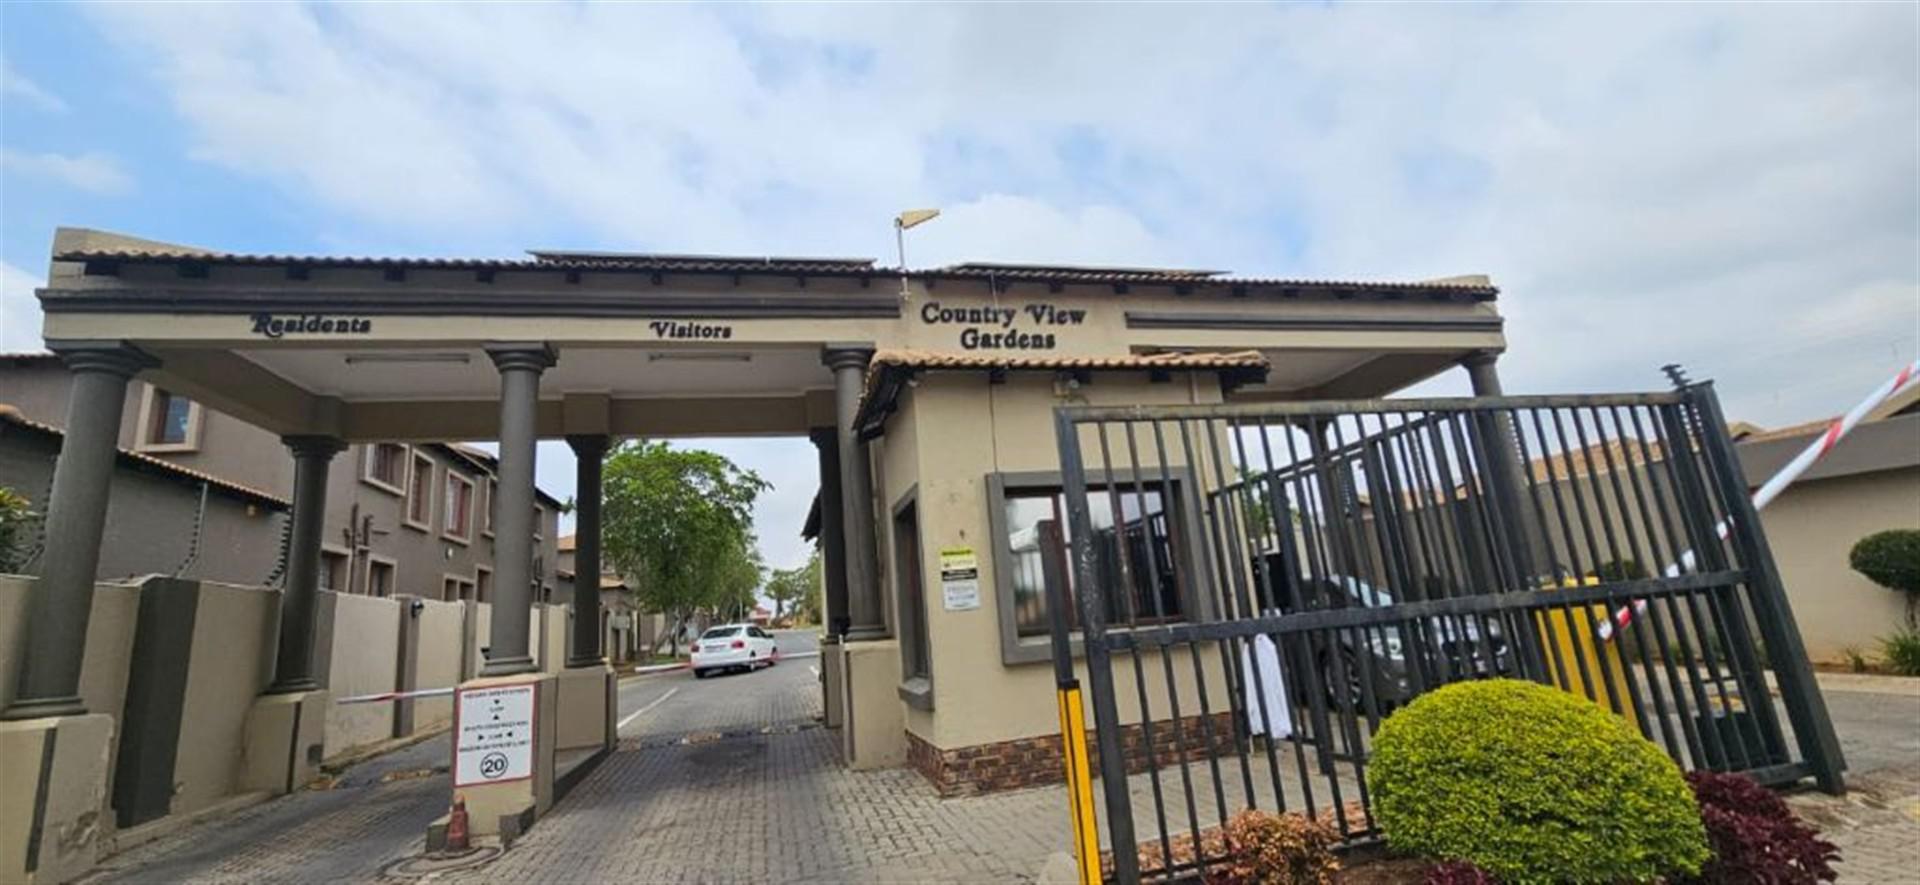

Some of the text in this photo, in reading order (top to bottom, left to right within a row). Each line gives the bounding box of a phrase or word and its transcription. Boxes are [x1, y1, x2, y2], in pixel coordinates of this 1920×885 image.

[250, 312, 371, 337] Residents
[921, 302, 1087, 327] Country View
[649, 321, 731, 338] Visitors
[960, 328, 1056, 349] Gardens
[483, 758, 505, 773] 20
